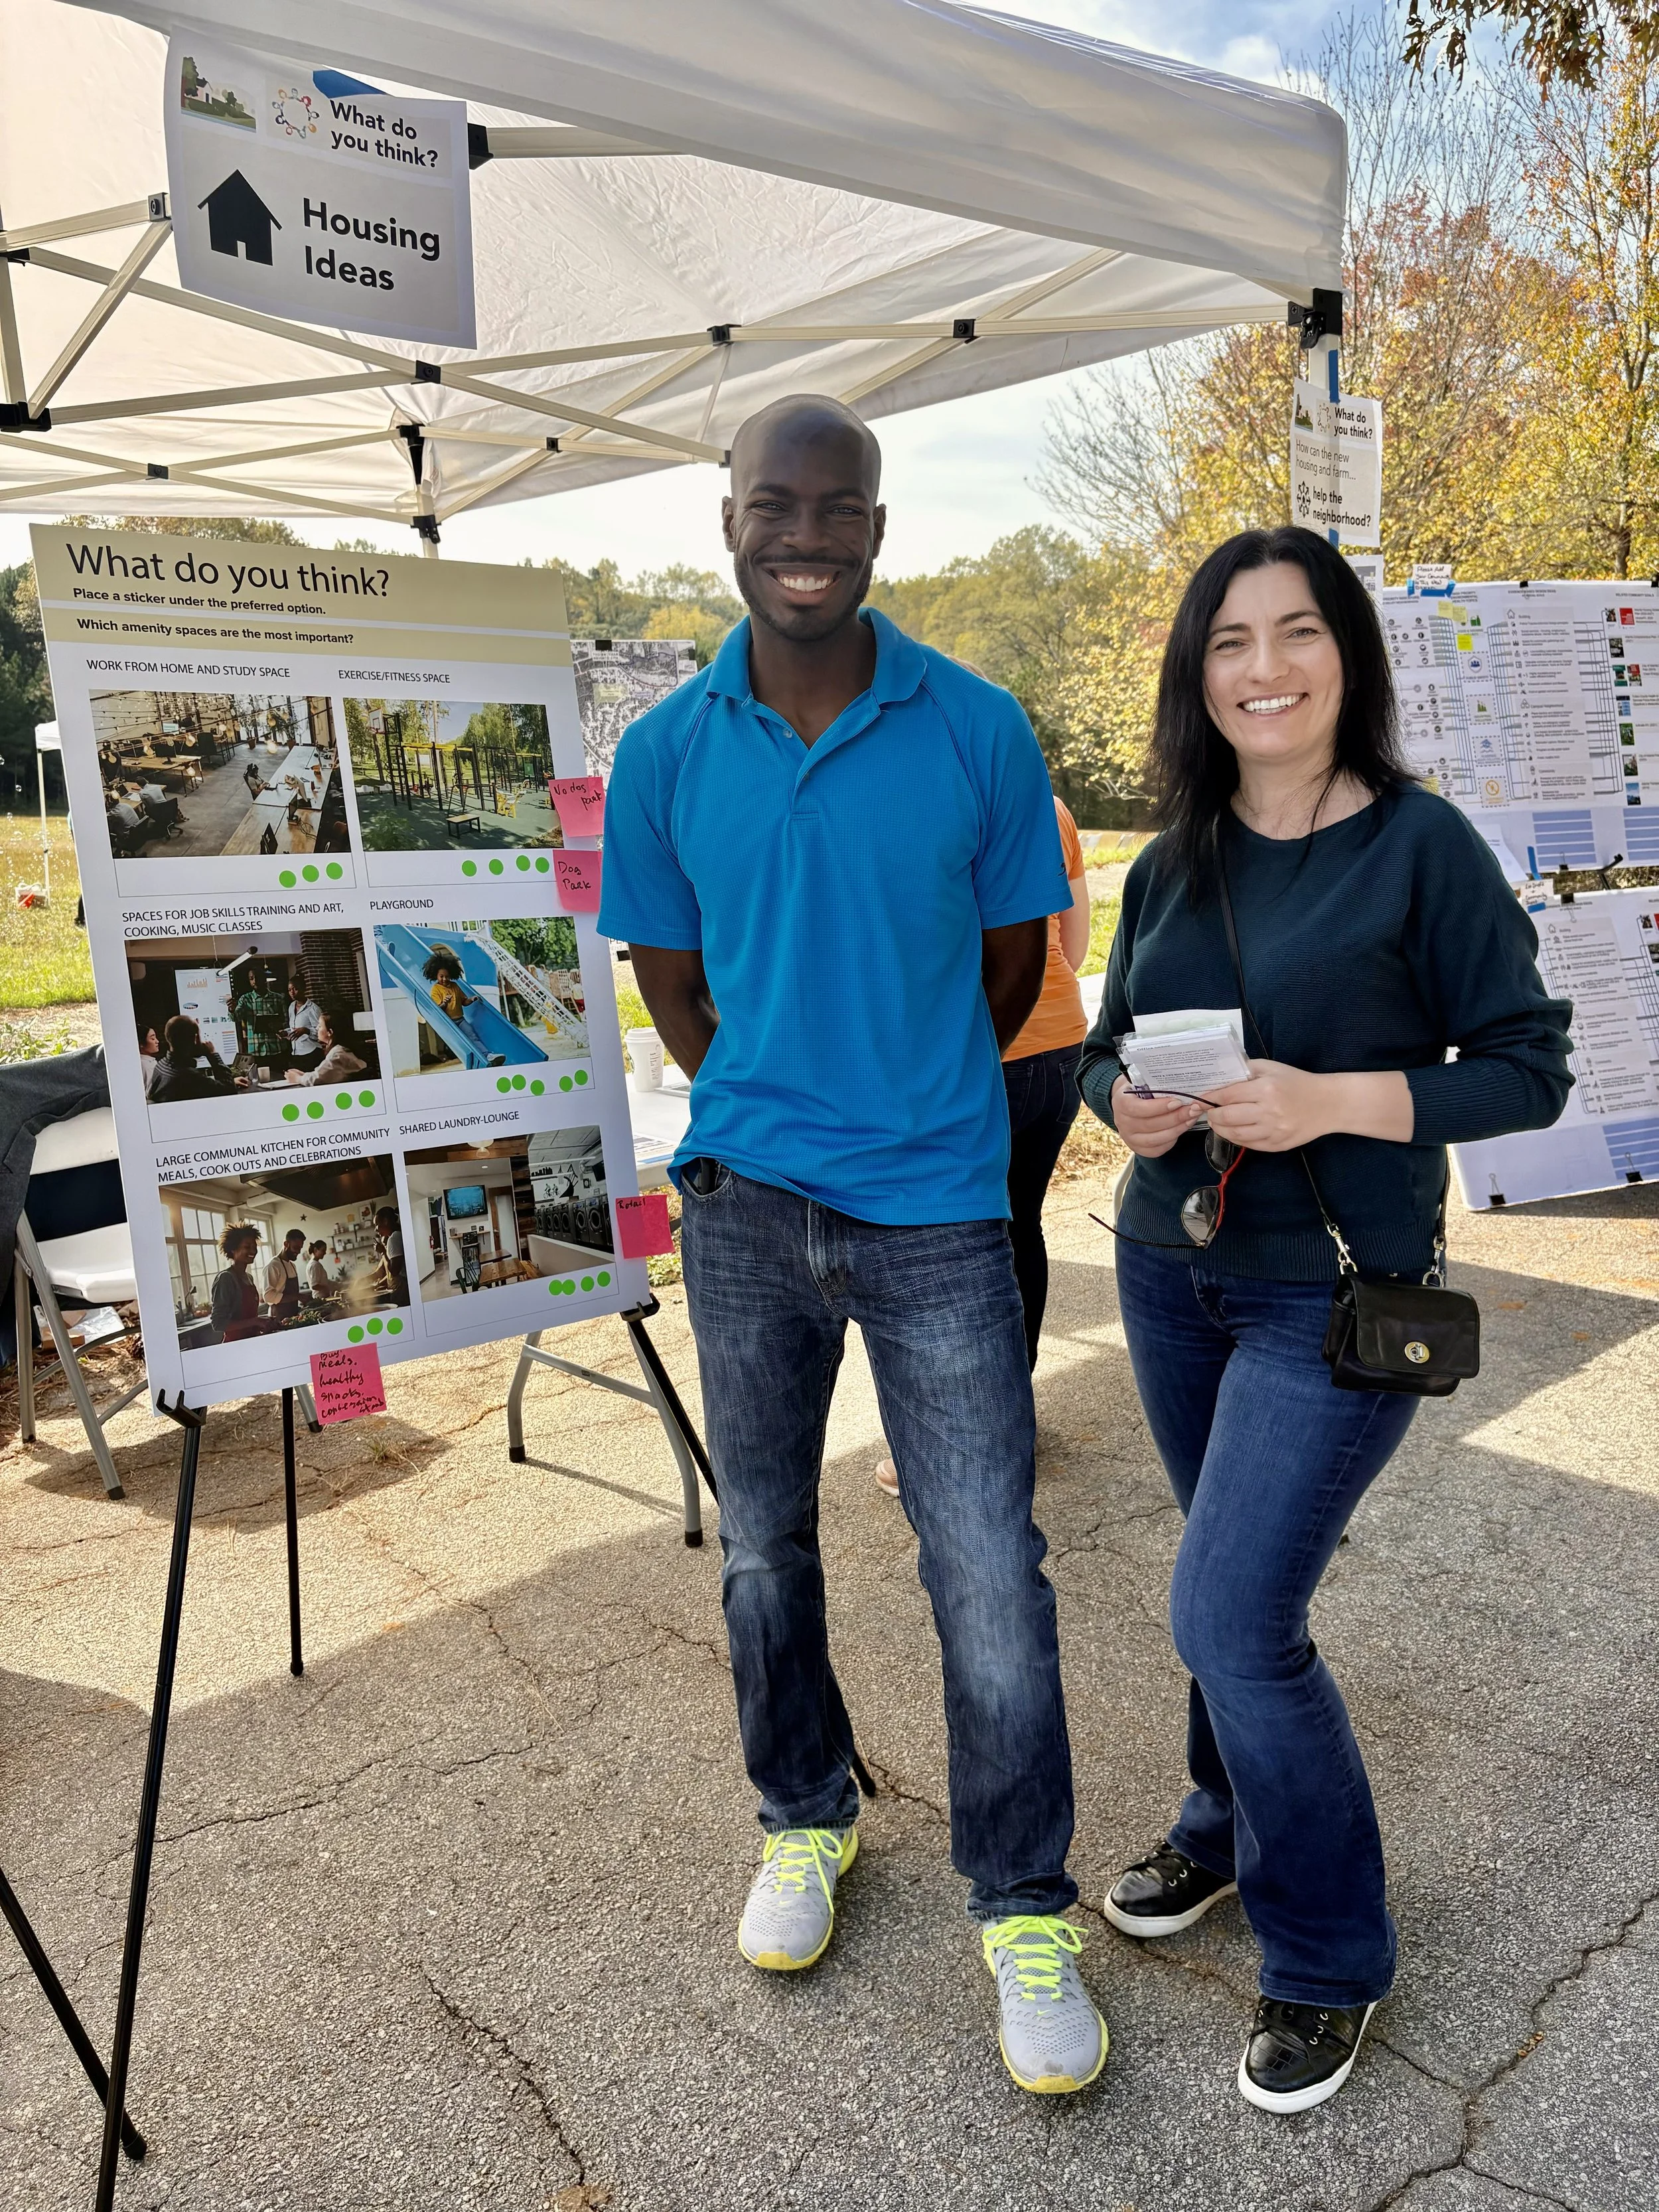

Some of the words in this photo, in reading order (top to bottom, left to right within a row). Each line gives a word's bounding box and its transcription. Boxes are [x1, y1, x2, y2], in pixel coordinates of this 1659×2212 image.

[330, 100, 385, 132] What
[391, 118, 417, 139] do
[331, 131, 368, 152] you
[375, 139, 438, 168] think?
[303, 198, 440, 261] Housing
[305, 246, 394, 291] Ideas
[1334, 407, 1354, 421] What
[1356, 411, 1366, 423] do
[1334, 425, 1348, 437] you
[1350, 427, 1373, 439] think?
[1296, 439, 1309, 454] How
[1310, 445, 1320, 457] can
[1321, 446, 1332, 461] the
[1334, 452, 1349, 463] new
[1296, 455, 1317, 477] housing
[1319, 463, 1331, 477] and
[1333, 465, 1356, 480] farm...
[1313, 485, 1327, 504] help
[1329, 490, 1342, 504] the
[1313, 508, 1371, 528] neighborhood?
[66, 544, 165, 580] What
[175, 553, 219, 584] do
[228, 565, 289, 594] you
[297, 563, 389, 597] think?
[73, 588, 109, 600] Place
[124, 592, 165, 604] sticker
[169, 595, 204, 607] under
[208, 598, 227, 608] the
[231, 599, 284, 611] preferred
[287, 603, 326, 615] option.
[76, 618, 117, 630] Which
[121, 623, 172, 636] amenity
[175, 625, 217, 636] spaces
[220, 628, 239, 638] are
[242, 628, 261, 638] the
[264, 631, 293, 640] most
[295, 631, 353, 643] important?
[86, 659, 123, 671] WORK
[125, 661, 159, 672] FROM
[161, 663, 194, 674] HOME
[196, 665, 220, 675] AND
[223, 666, 257, 676] STUDY
[259, 667, 291, 678] SPACE
[338, 670, 421, 682] EXERCISE/FITNESS
[423, 673, 451, 684] SPACE
[553, 784, 567, 796] No
[558, 861, 582, 875] Dog
[563, 878, 591, 891] Park
[122, 911, 163, 922] SPACES
[165, 909, 188, 920] FOR
[190, 909, 210, 919] JOB
[212, 907, 245, 918] SKILLS
[246, 904, 296, 917] TRAINING
[298, 903, 321, 914] AND
[323, 903, 344, 913] ART,
[370, 899, 434, 911] PLAYGROUND
[124, 925, 179, 937] COOKING,
[182, 923, 216, 934] MUSIC
[218, 921, 263, 932] CLASSES
[399, 1122, 437, 1135] SHARED
[439, 1111, 520, 1130] LAUNDRY-LOUNGE
[156, 1153, 192, 1167] LARGE
[193, 1145, 259, 1161] COMMUNAL
[261, 1140, 304, 1153] KITCHEN
[307, 1136, 326, 1147] FOR
[328, 1128, 390, 1144] COMMUNITY
[158, 1168, 198, 1183] MEALS,
[200, 1163, 231, 1176] COOK
[233, 1159, 261, 1172] OUTS
[264, 1156, 287, 1167] AND
[289, 1145, 361, 1164] CELEBRATIONS
